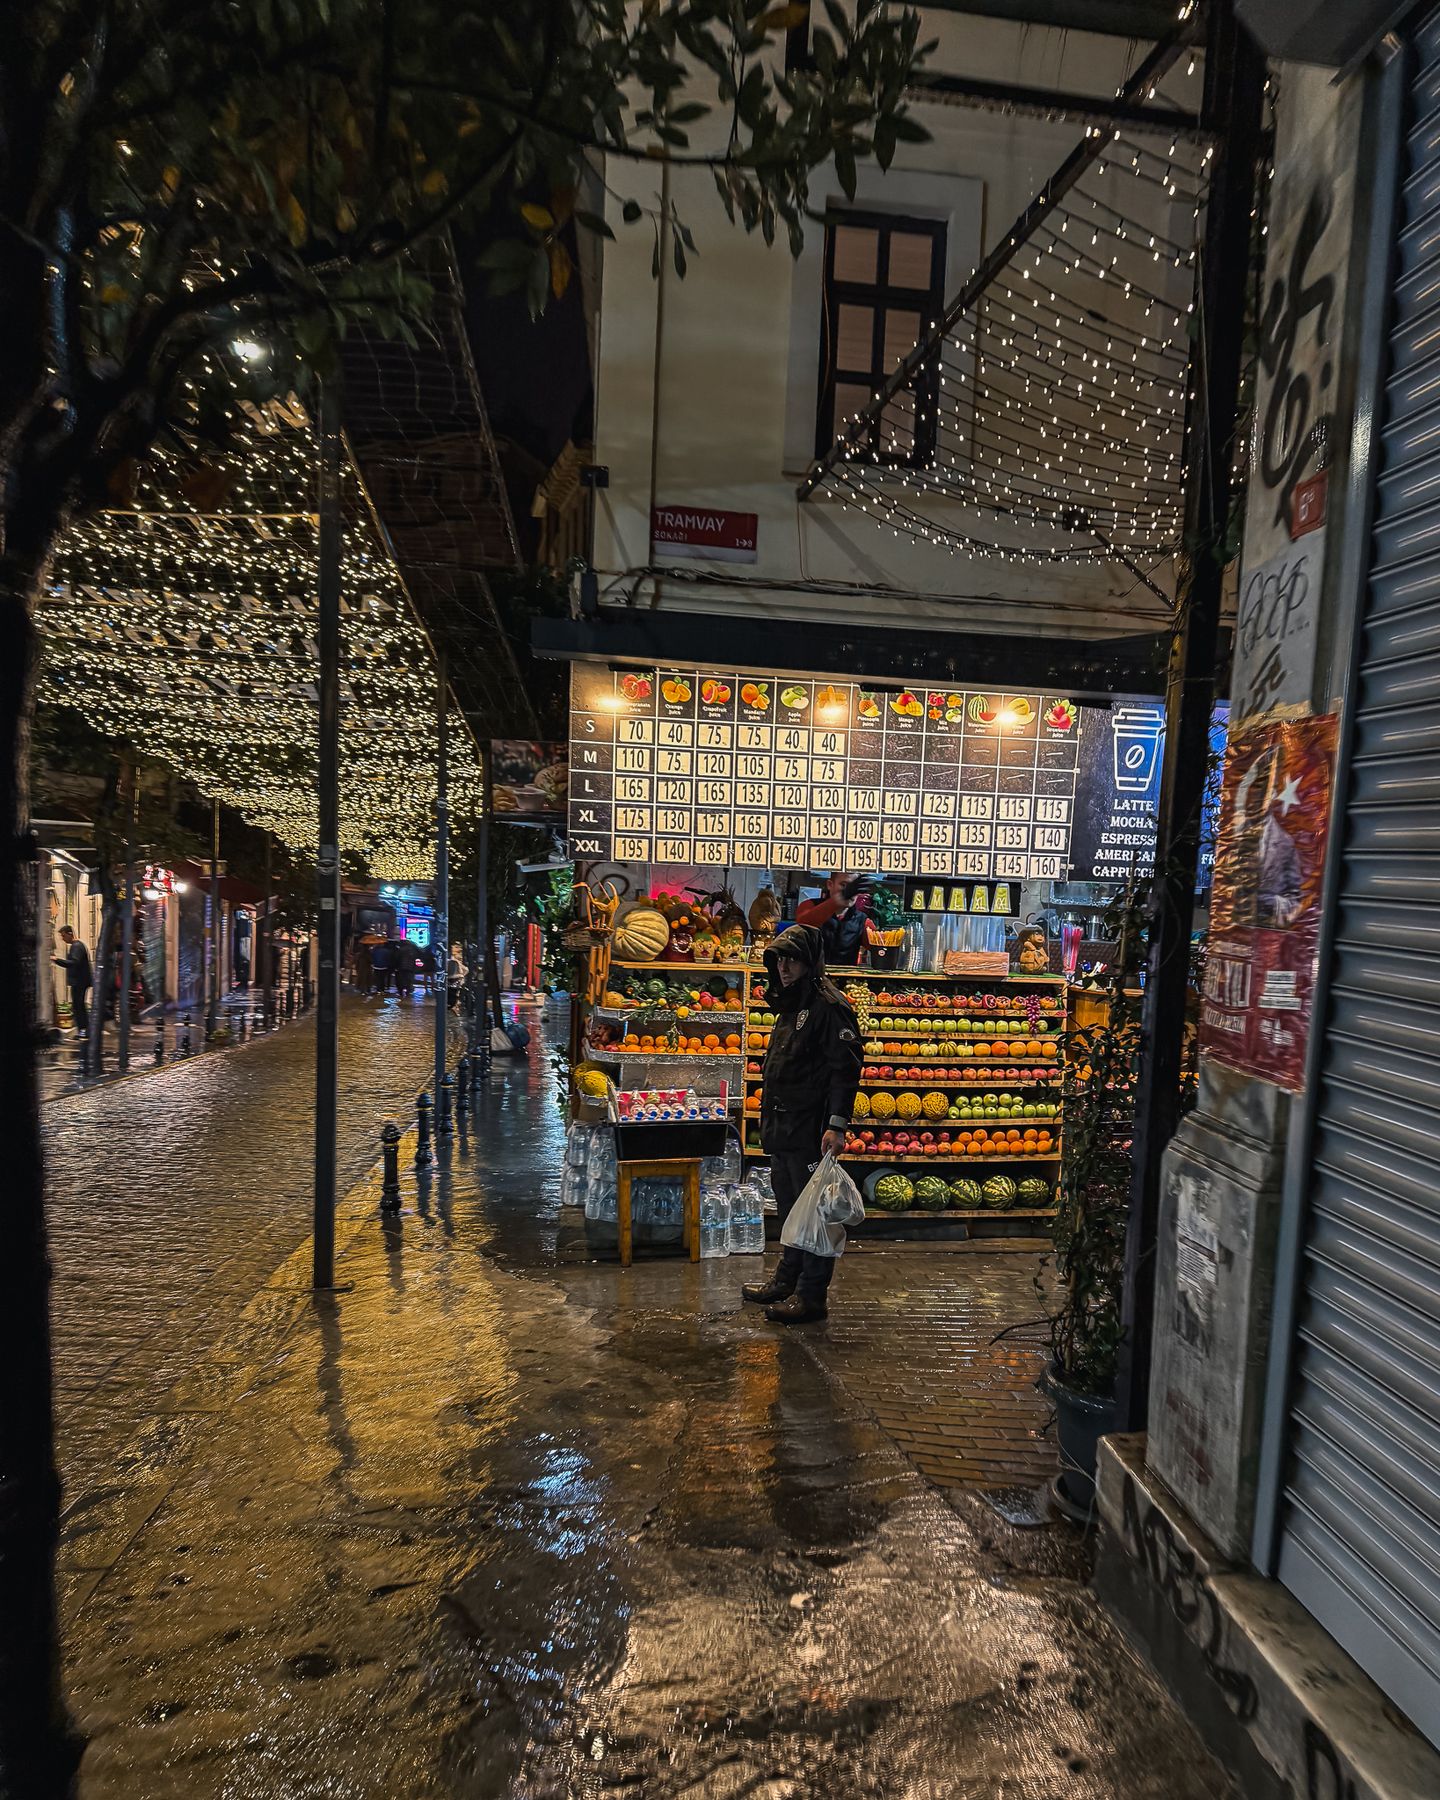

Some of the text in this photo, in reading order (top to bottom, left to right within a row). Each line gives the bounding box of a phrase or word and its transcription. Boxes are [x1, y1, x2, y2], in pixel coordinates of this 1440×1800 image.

[656, 512, 725, 532] TRAMVAY
[585, 720, 595, 733] S
[629, 721, 836, 751] 70 40 75 75 40 40
[584, 751, 597, 763] M
[623, 750, 834, 779] 110 75 120 105 75 75
[585, 780, 594, 792] L
[623, 779, 1062, 818] 165 120 165 135 120 120 170 170 125 115 115 115
[1114, 799, 1154, 811] LATTE
[579, 810, 598, 823] XL
[1110, 816, 1153, 828] MOCHA
[623, 809, 1060, 846] 175 130 175 165 130 130 180 180 135 135 135 140
[1101, 833, 1157, 845] ESPRESS
[575, 840, 603, 853] XXL
[622, 840, 1055, 875] 195 140 185 180 140 140 195 195 155 145 145 160
